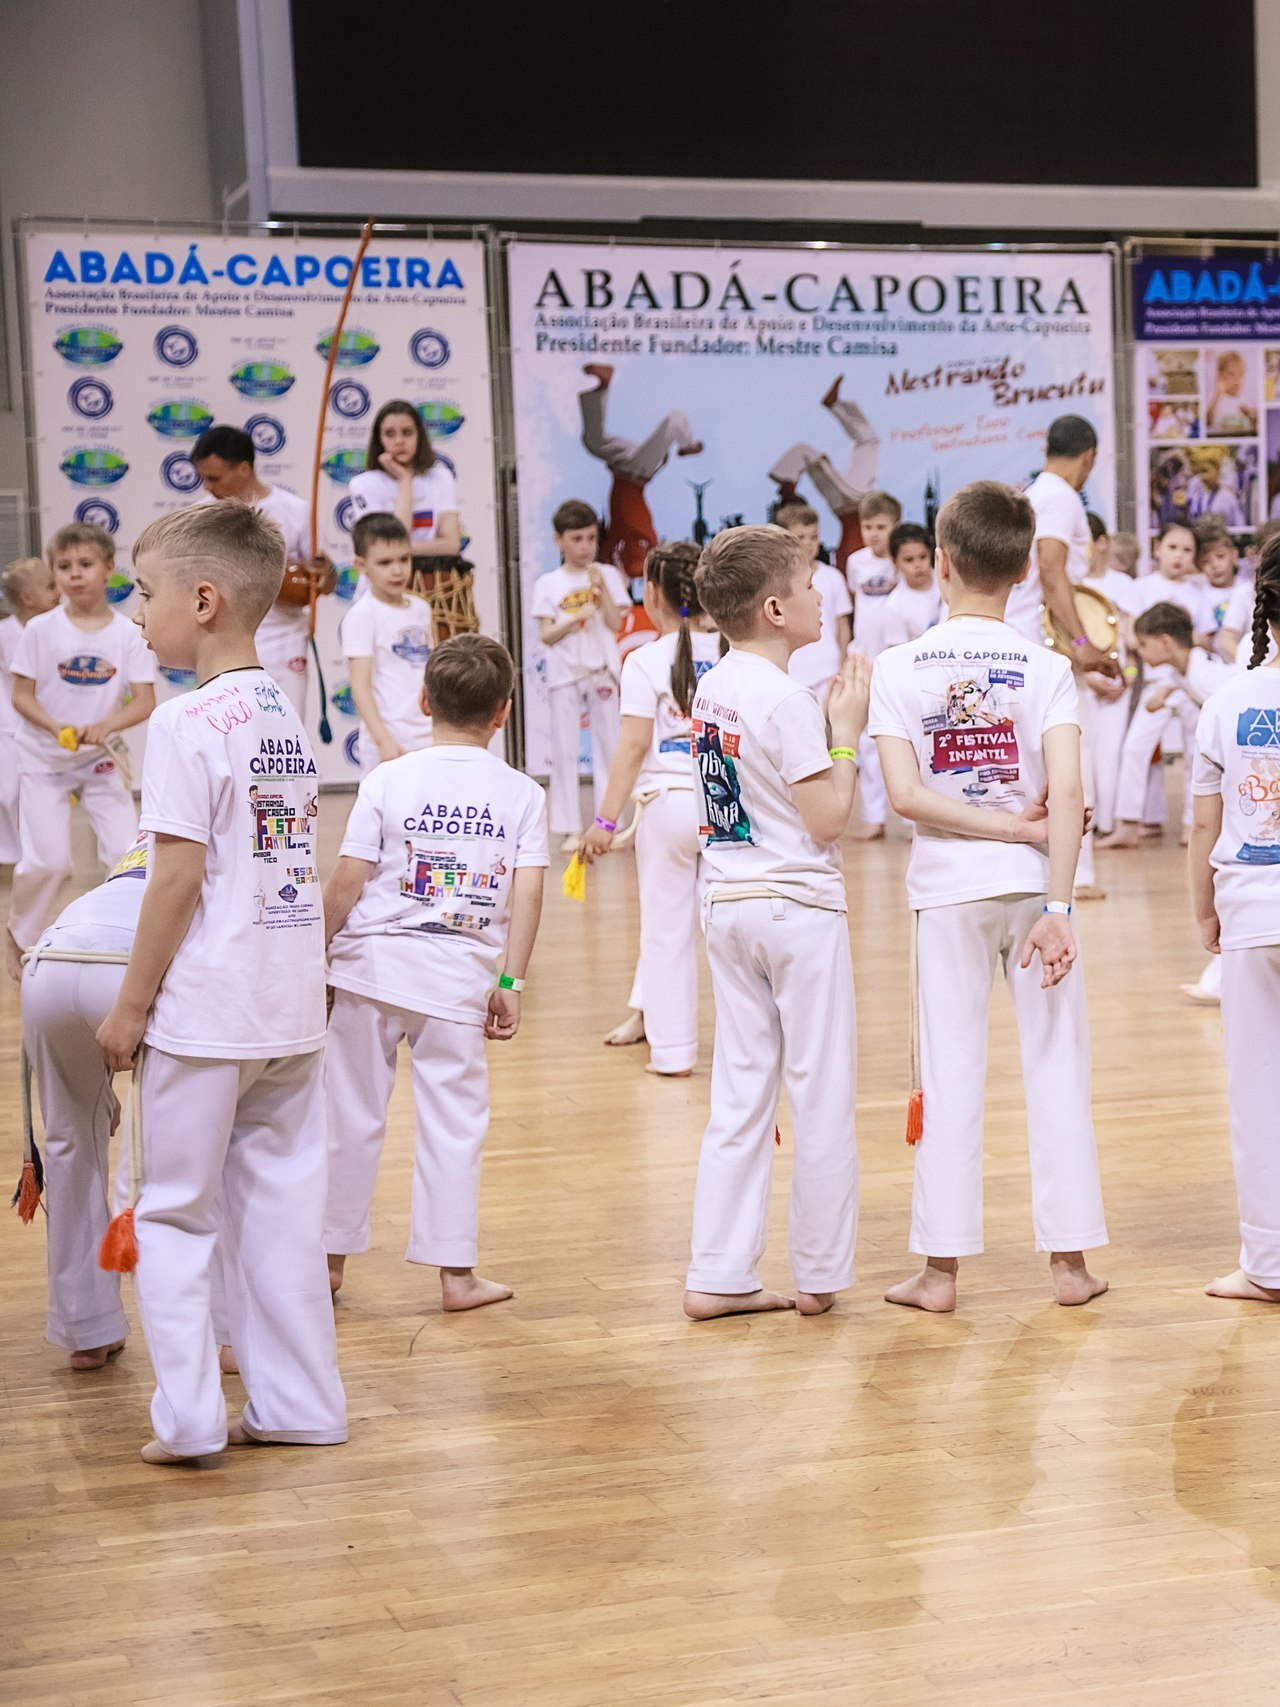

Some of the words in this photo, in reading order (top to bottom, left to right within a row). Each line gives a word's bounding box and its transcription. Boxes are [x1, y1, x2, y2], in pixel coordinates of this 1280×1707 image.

[44, 243, 464, 289] ABADÁ-CAPOEIRA
[534, 259, 1090, 314] ABADÁ-CAPOEIRA
[535, 332, 642, 353] Presidente
[755, 335, 821, 355] Mestre
[827, 335, 898, 355] Camisa
[260, 735, 303, 755] ABADÁ
[949, 748, 1008, 762] INFANTIL
[249, 757, 317, 774] CAPOEIRA
[421, 803, 492, 821] ABADÁ
[404, 817, 506, 839] CAPOEIRA
[415, 860, 499, 892] FESTIVAL
